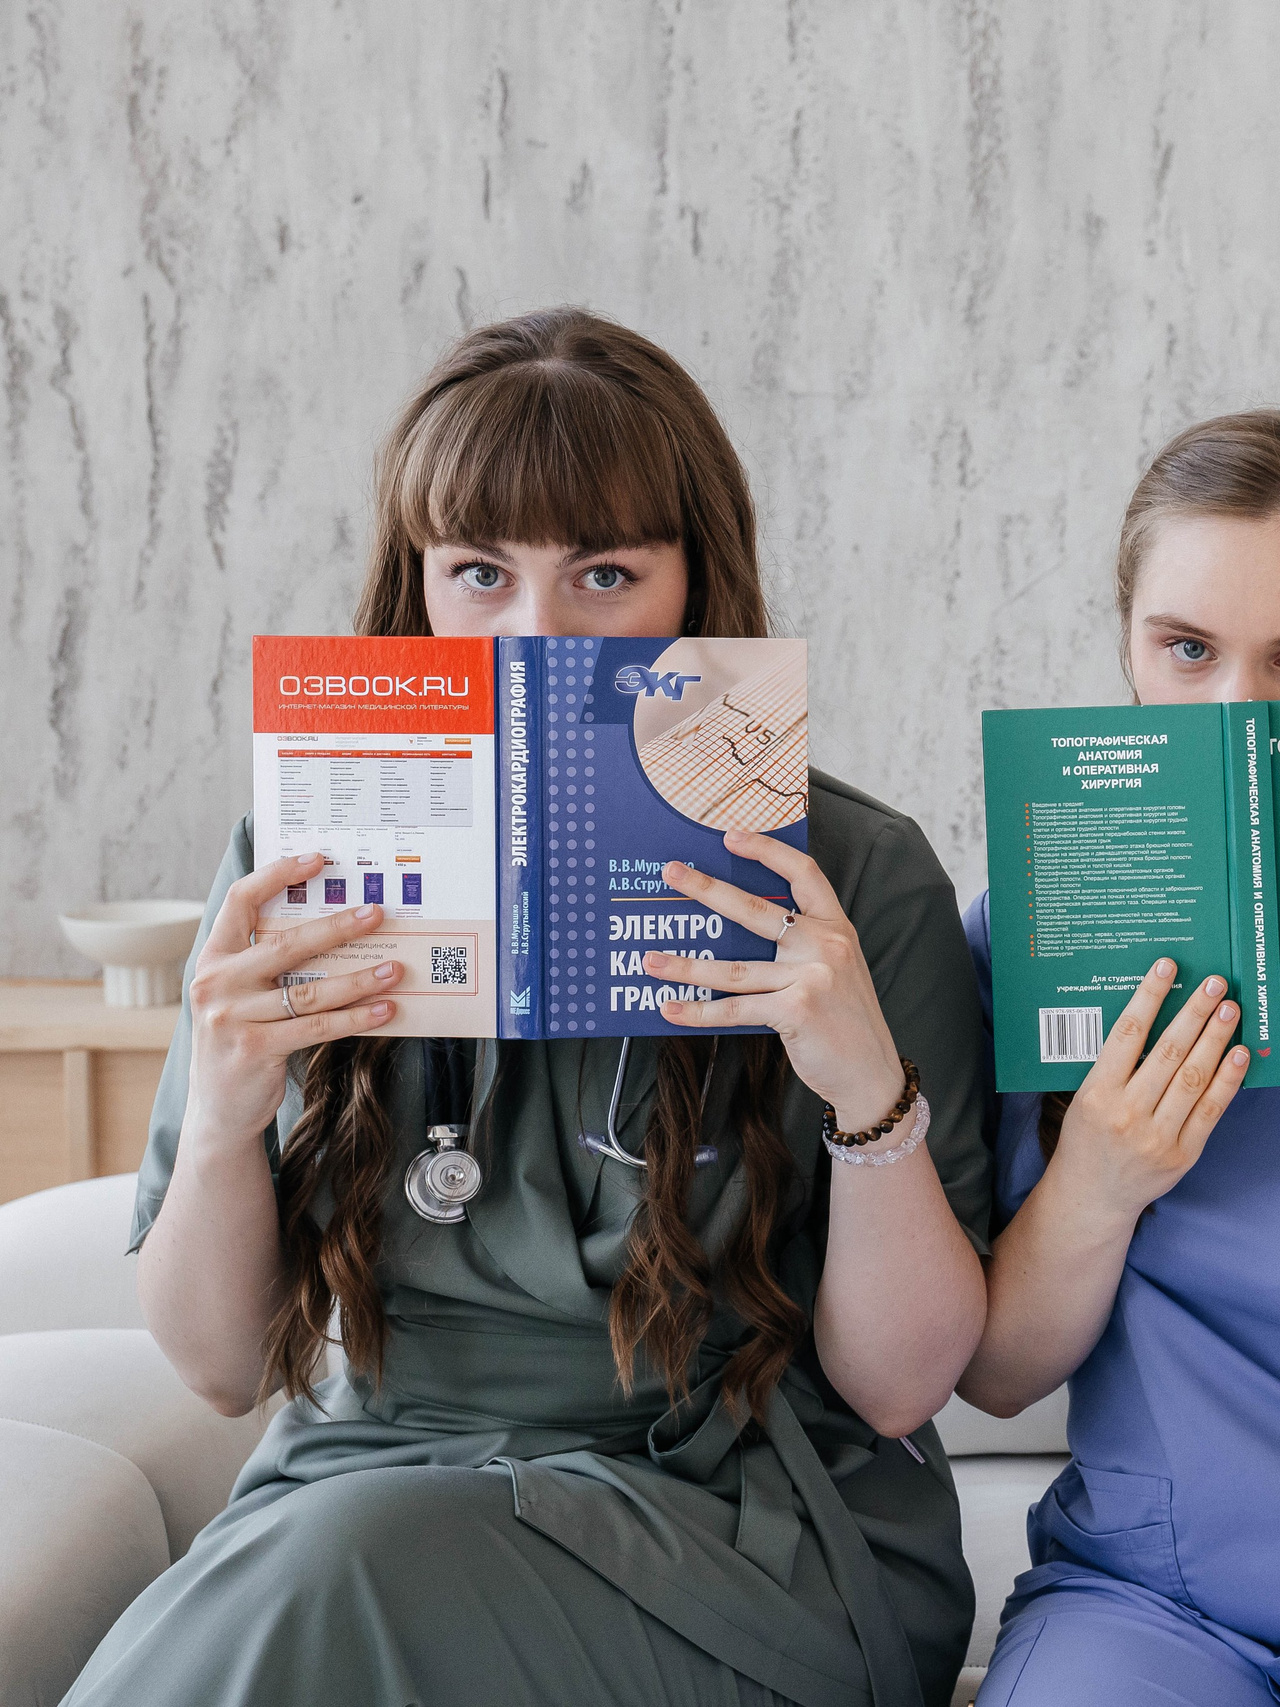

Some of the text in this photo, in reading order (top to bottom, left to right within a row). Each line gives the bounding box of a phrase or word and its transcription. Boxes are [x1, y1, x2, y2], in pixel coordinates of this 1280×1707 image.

[615, 665, 702, 701] ЭКГ
[358, 703, 417, 711] МЕДИЦИНСКОЙ
[1051, 734, 1168, 748] ТОПОГРАФИЧЕСКАЯ
[1077, 750, 1142, 761] АНАТОМИЯ
[510, 661, 529, 867] ЭЛЕКТРОКАРДИОГРАФИЯ
[1062, 763, 1159, 776] И ОПЕРАТИВНАЯ
[1081, 778, 1142, 790] ХИРУРГИЯ
[1246, 717, 1269, 1041] ТОПОГРАФИЧЕСКАЯ АНАТОМИЯ И ОПЕРАТИВНАЯ ХИРУРГИЯ
[511, 904, 520, 955] В.В.Мурашко
[521, 891, 530, 955] А.В.Струтынский
[609, 914, 723, 941] ЭЛЕКТРО
[349, 942, 397, 950] медицинская
[1091, 975, 1144, 983] Для студентов
[1057, 984, 1101, 993] учреждений
